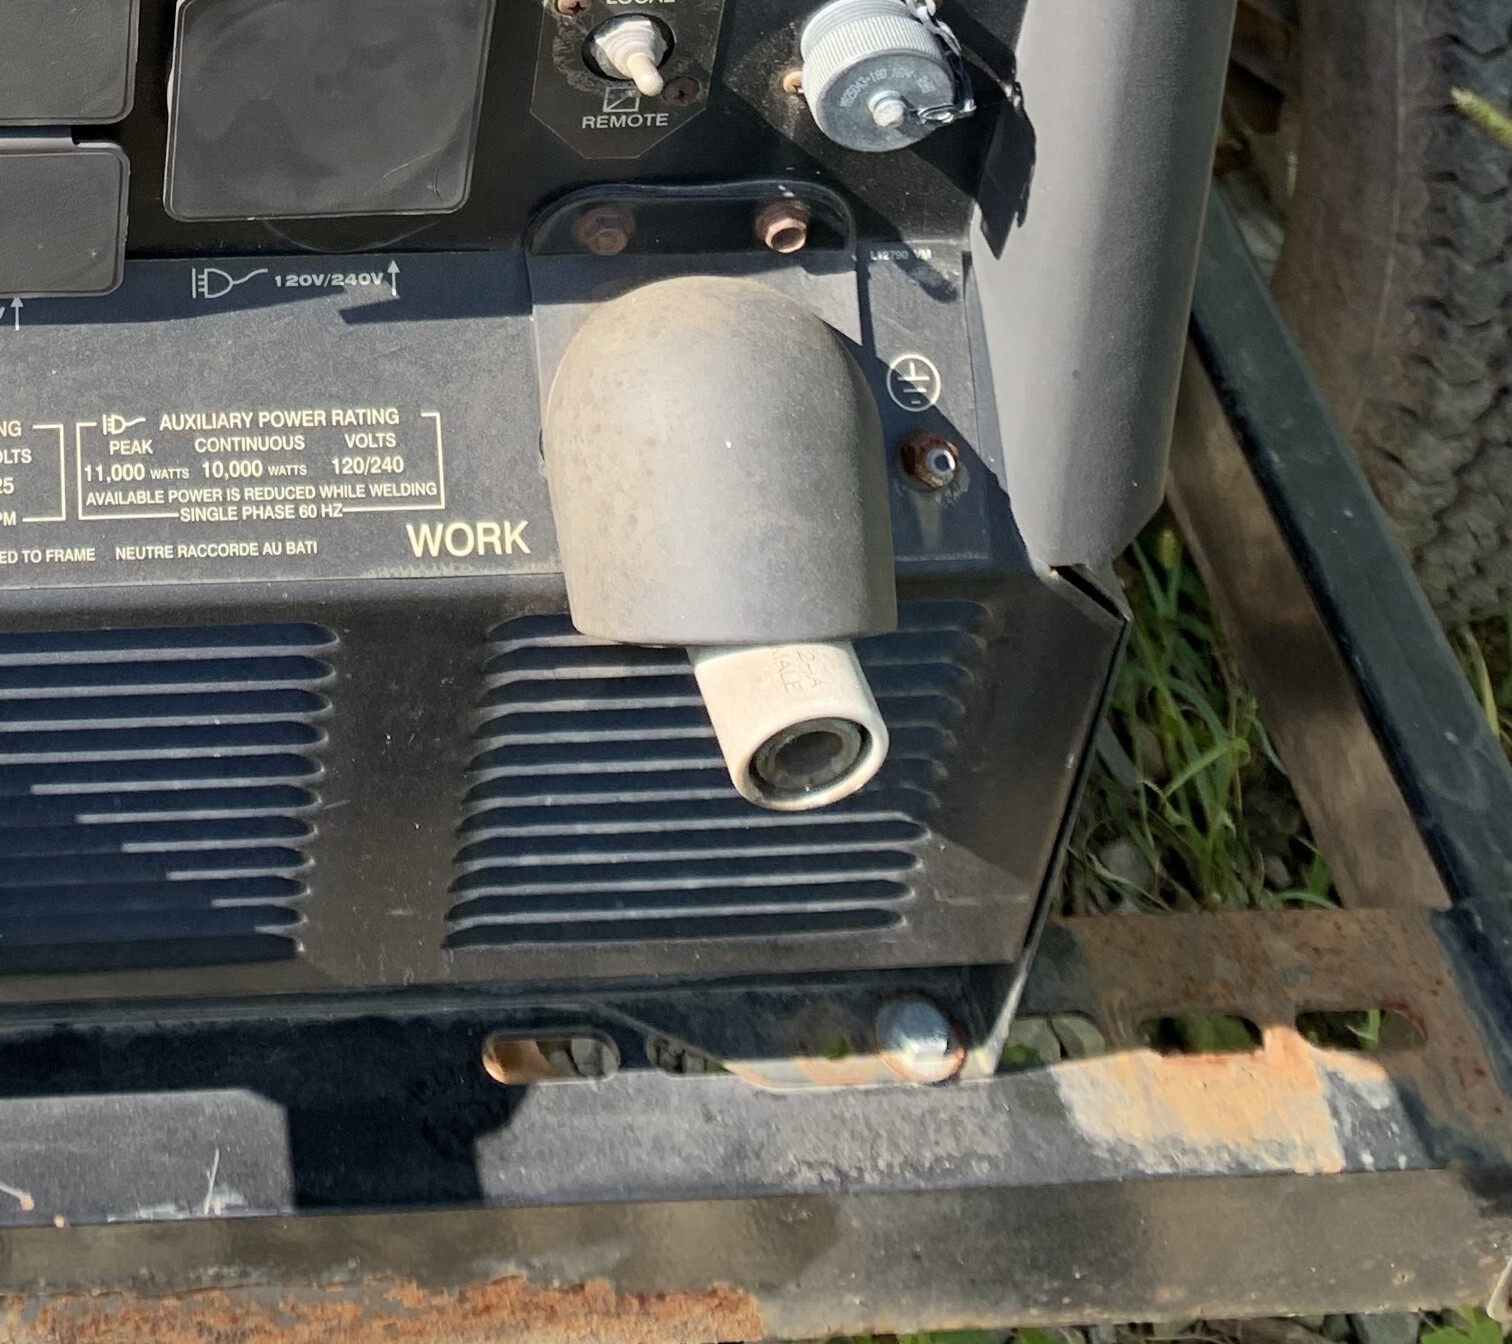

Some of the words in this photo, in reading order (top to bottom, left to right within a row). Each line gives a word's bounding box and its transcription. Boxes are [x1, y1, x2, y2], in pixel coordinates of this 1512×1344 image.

[581, 113, 669, 129] REMOTE
[274, 271, 384, 288] 120V/240V
[159, 412, 254, 431] AUXILIARY
[258, 410, 327, 429] POWER
[332, 408, 400, 426] RATING
[109, 440, 154, 455] PEAK
[194, 435, 305, 453] CONTINUOUS
[344, 433, 397, 449] VOLTS
[84, 463, 145, 484] 11,000
[150, 468, 190, 480] WATTS
[202, 460, 263, 480] 10,000
[267, 465, 308, 477] WATTS
[332, 456, 404, 475] 120/240
[86, 489, 165, 506] AVAILABLE
[168, 487, 224, 503] POWER
[226, 486, 241, 502] IS
[244, 484, 316, 501] REDUCED
[320, 483, 366, 499] WHILE
[369, 480, 438, 498] WELDING
[180, 506, 238, 523] SINGLE
[242, 505, 295, 521] PHASE
[299, 503, 317, 518] 60
[321, 502, 343, 517] HZ
[406, 520, 530, 559] WORK
[22, 549, 41, 564] TO
[45, 547, 96, 563] FRAME
[115, 543, 174, 561] NEUTRE
[178, 542, 258, 559] RACCORDE
[262, 541, 281, 556] AU
[285, 540, 318, 555] BATI
